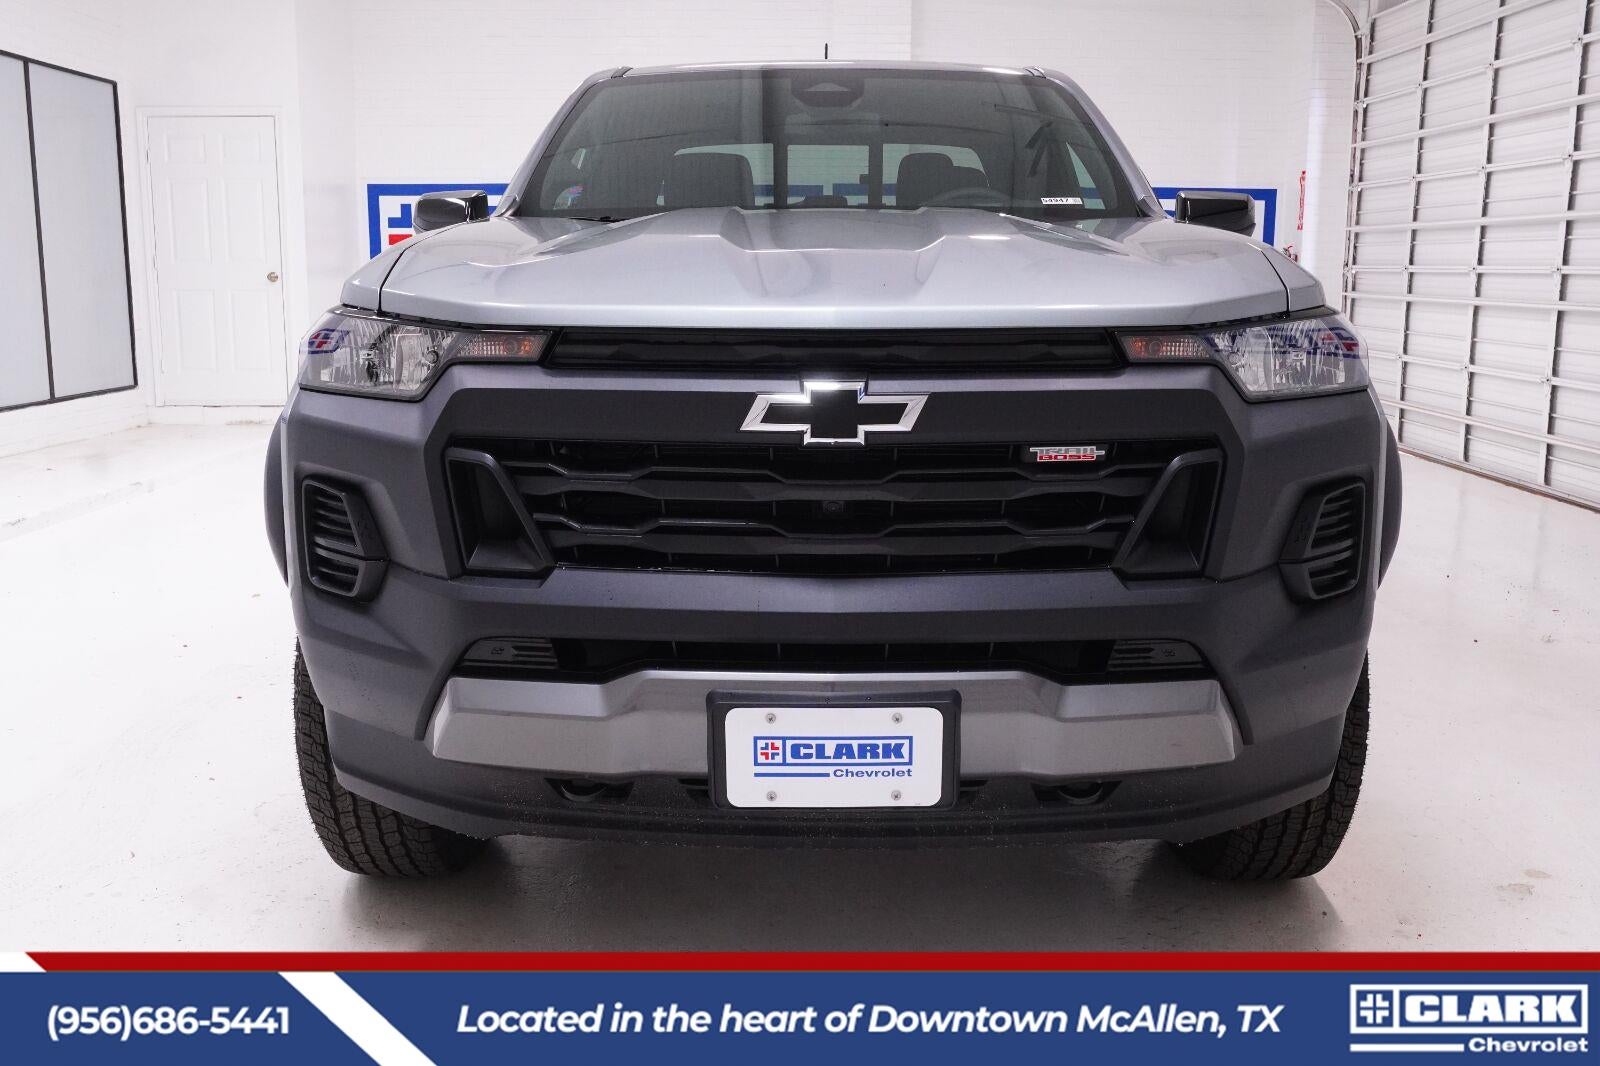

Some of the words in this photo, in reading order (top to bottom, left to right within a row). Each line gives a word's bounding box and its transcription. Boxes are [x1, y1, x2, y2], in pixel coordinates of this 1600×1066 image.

[1030, 446, 1105, 455] TRAIL
[1037, 454, 1097, 462] BOSS
[790, 743, 906, 760] CLARK
[833, 768, 913, 778] Chevrolet
